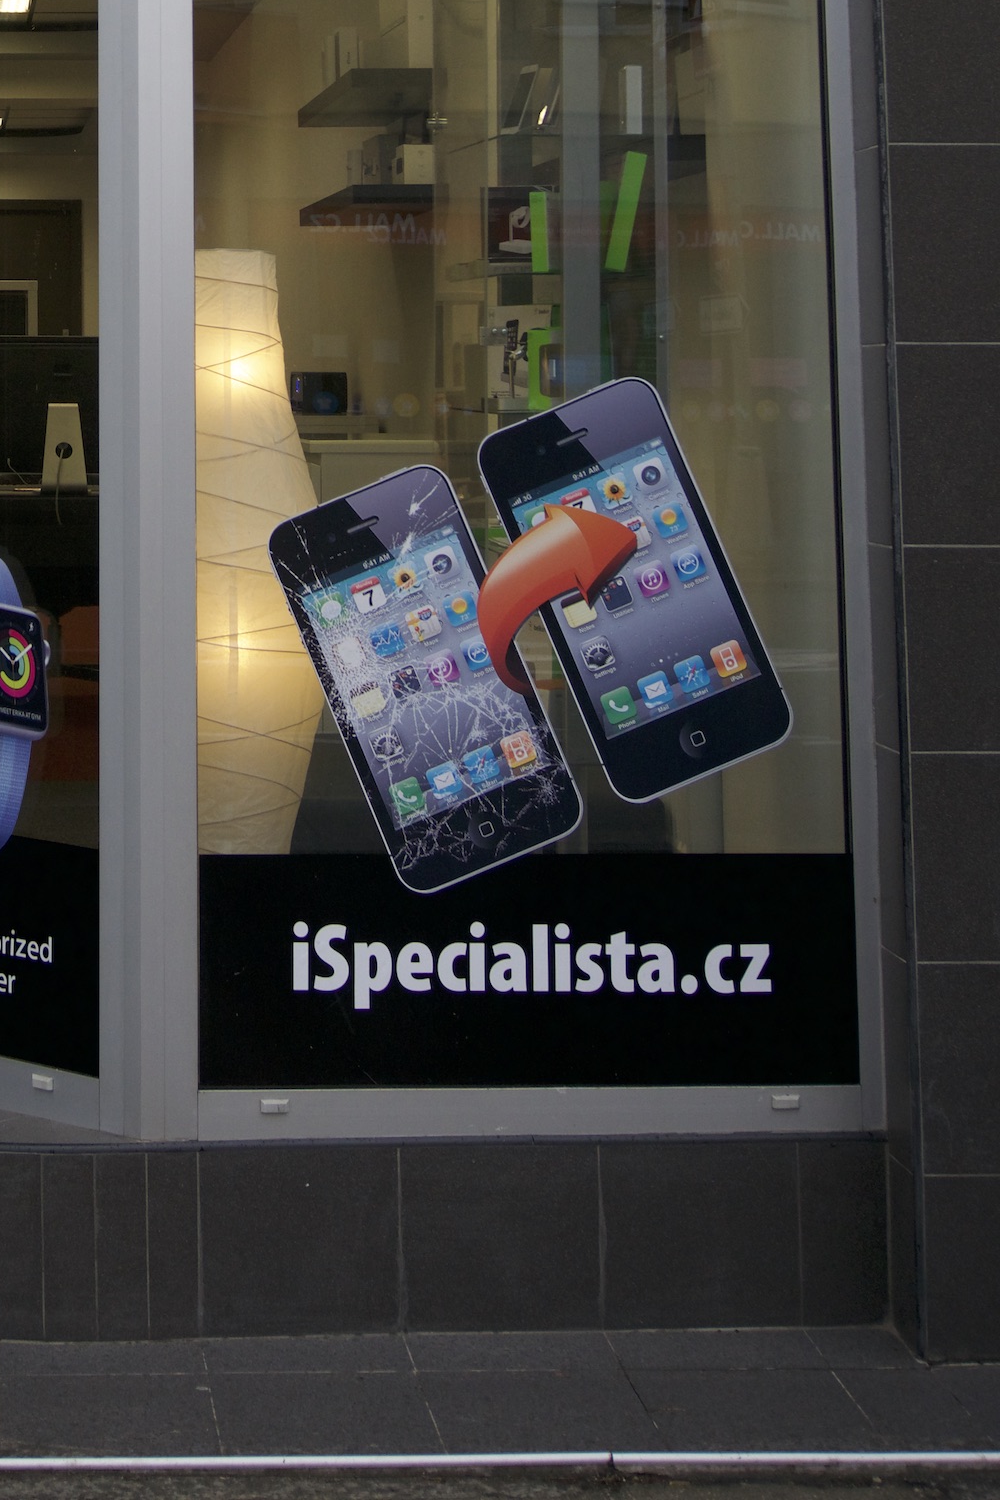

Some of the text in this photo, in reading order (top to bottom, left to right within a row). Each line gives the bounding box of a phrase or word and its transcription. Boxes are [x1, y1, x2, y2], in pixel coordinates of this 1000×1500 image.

[572, 464, 600, 481] 9:41 AM
[522, 494, 532, 503] 3G
[613, 504, 633, 515] Photos
[666, 531, 688, 544] Weather
[633, 550, 649, 559] Maps
[362, 552, 391, 569] 9:41 AM
[355, 580, 373, 589] Monday
[683, 575, 710, 590] App Store
[362, 589, 374, 607] 7
[651, 593, 669, 604] iTunes
[578, 623, 595, 634] Notes
[424, 637, 439, 647] Maps
[473, 665, 495, 680] App Sto
[594, 666, 617, 679] Settings
[730, 673, 744, 682] iPod
[691, 687, 709, 699] Safari
[657, 704, 670, 713] Mail
[617, 718, 637, 730] Phone
[519, 764, 534, 773] iPod
[292, 920, 772, 1010] iSpecialista.cz
